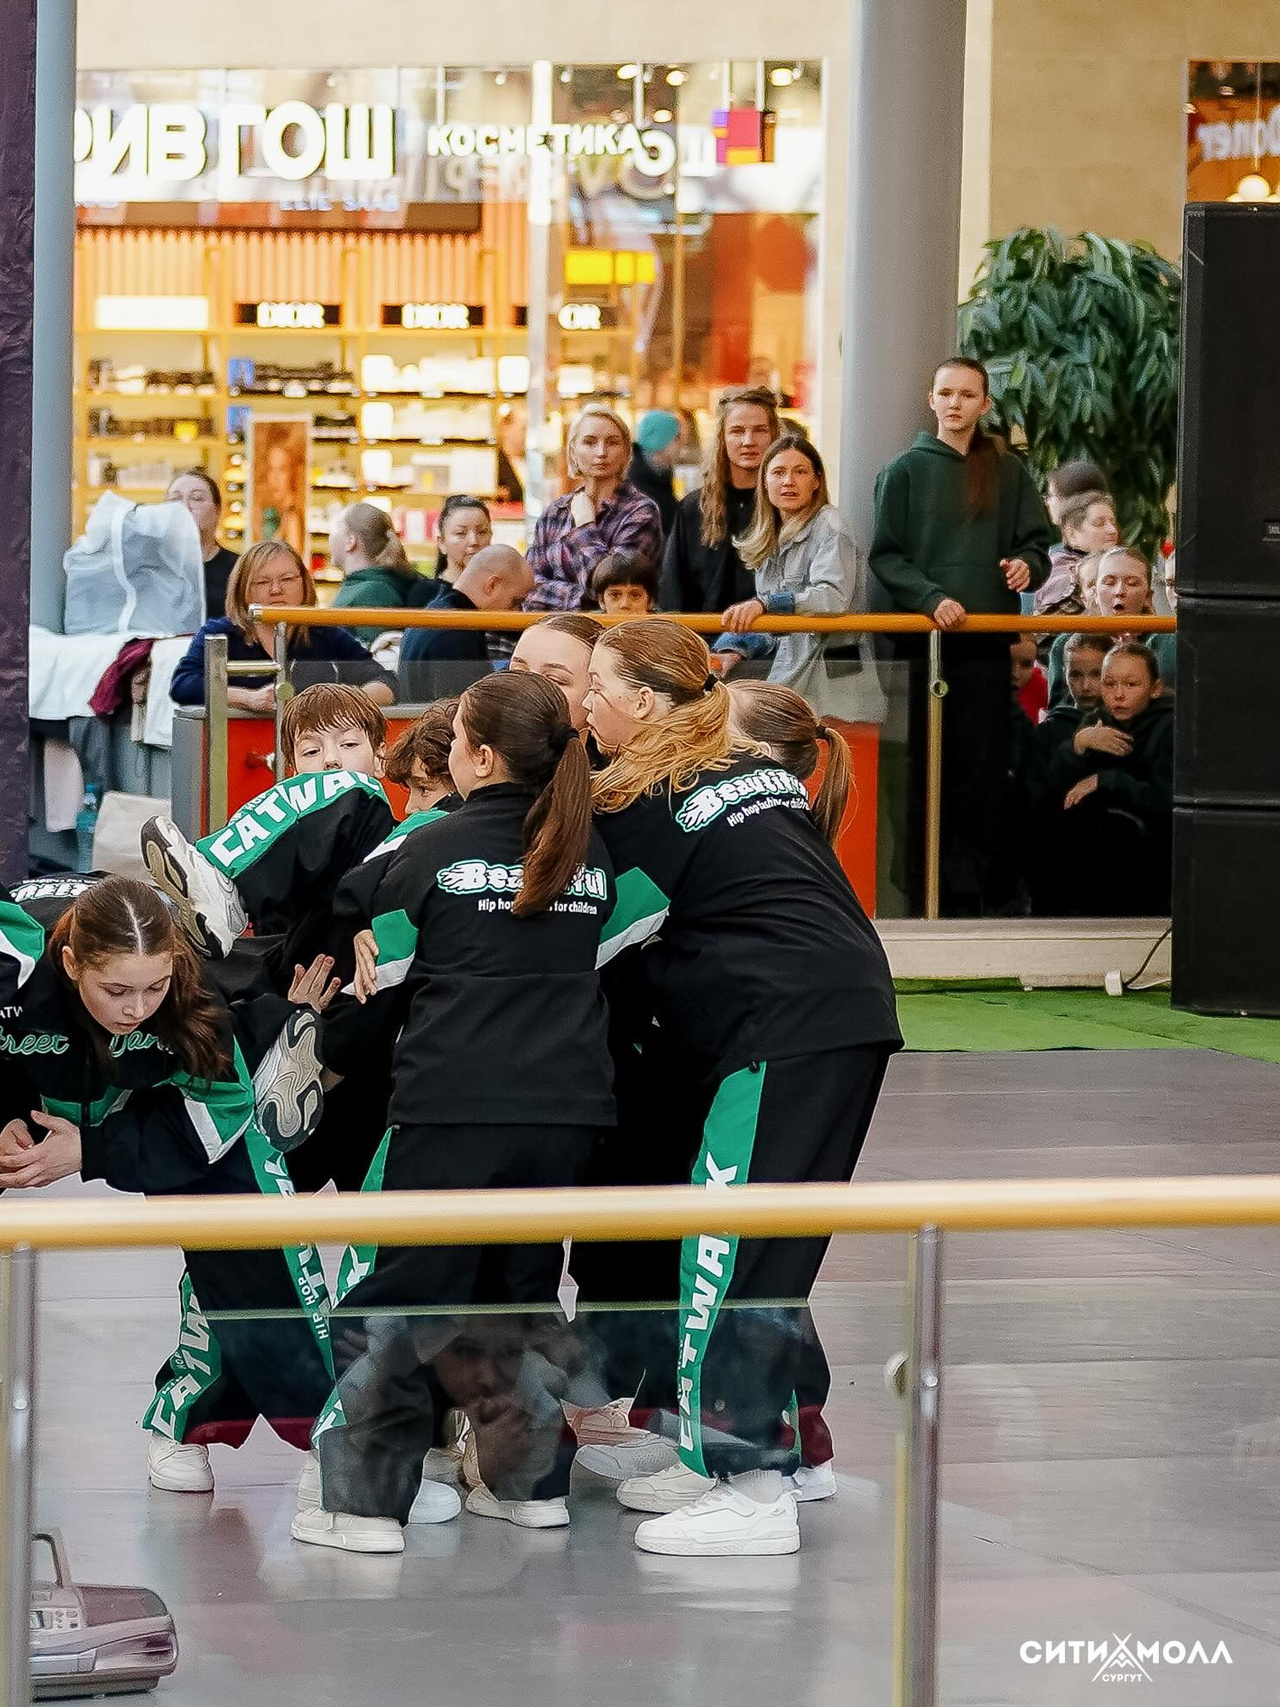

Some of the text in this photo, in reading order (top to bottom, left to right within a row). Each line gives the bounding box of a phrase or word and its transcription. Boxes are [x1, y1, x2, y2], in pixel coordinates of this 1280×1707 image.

[220, 100, 396, 181] ГОШ
[427, 123, 643, 157] КОСМЕТИКА
[402, 301, 469, 330] DIOR
[209, 770, 380, 867] CATWAL
[478, 899, 496, 913] Hip
[554, 901, 568, 912] for
[297, 1275, 315, 1307] HOP
[677, 1151, 738, 1452] CATWAK
